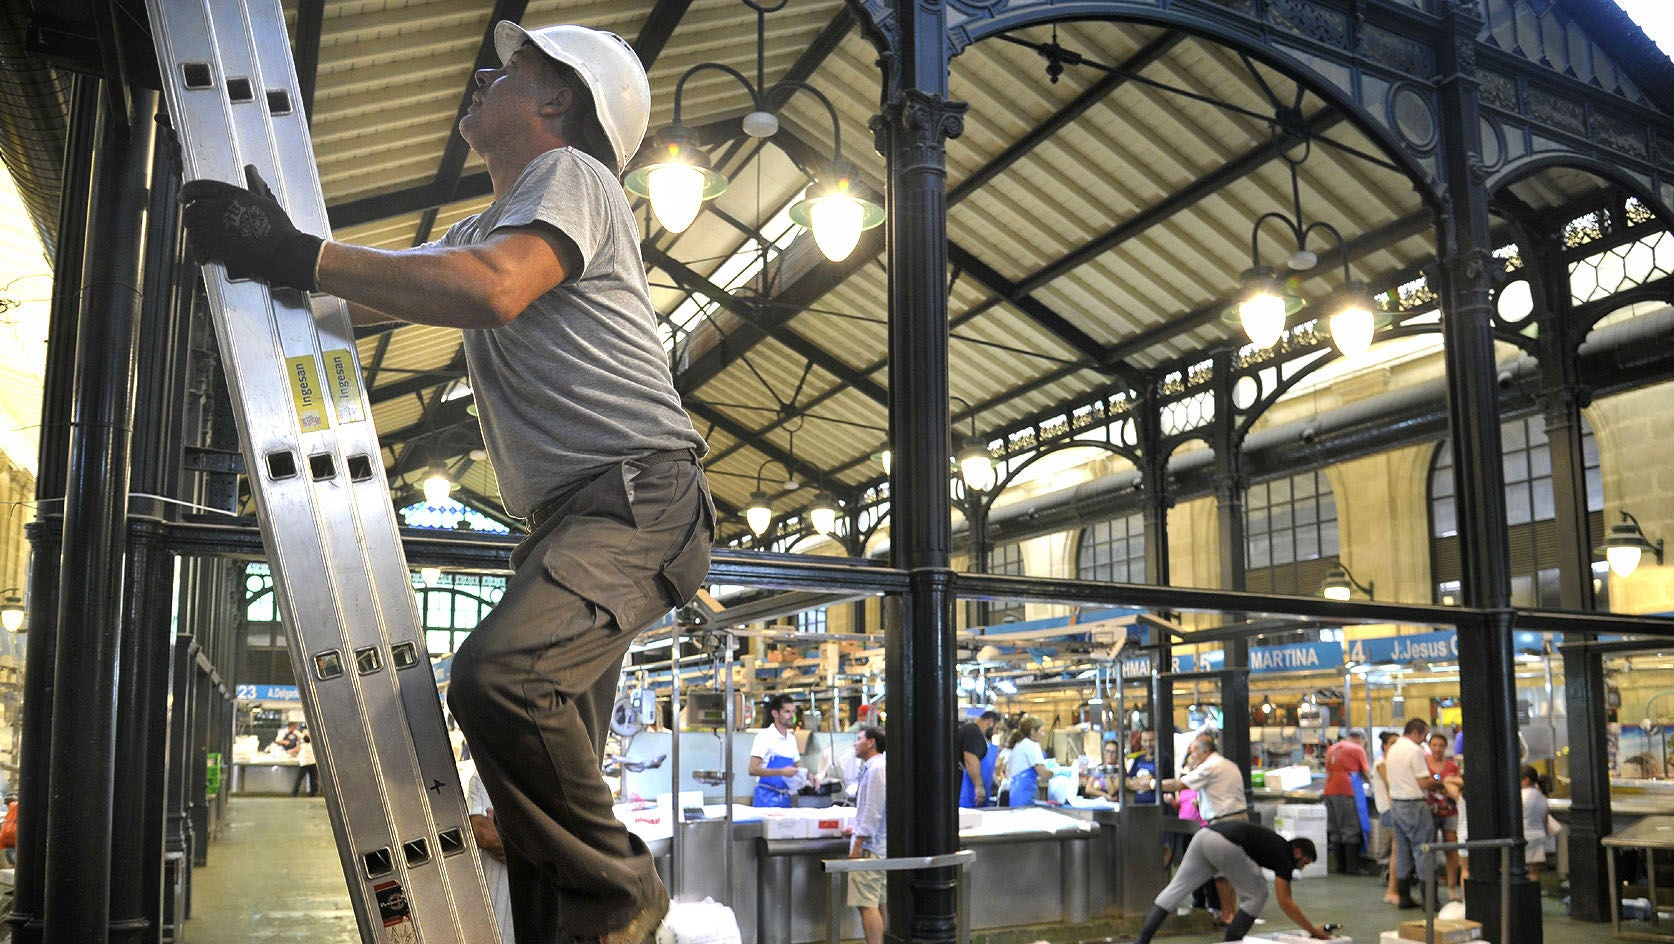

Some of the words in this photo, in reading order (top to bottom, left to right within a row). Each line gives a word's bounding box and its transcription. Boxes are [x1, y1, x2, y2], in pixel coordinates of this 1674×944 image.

[295, 363, 312, 407] Ingesan
[333, 356, 349, 399] Ingesan
[1250, 646, 1319, 669] MARTINA
[1351, 640, 1365, 663] 4
[1391, 639, 1448, 660] J.Jesus
[237, 684, 257, 700] 23
